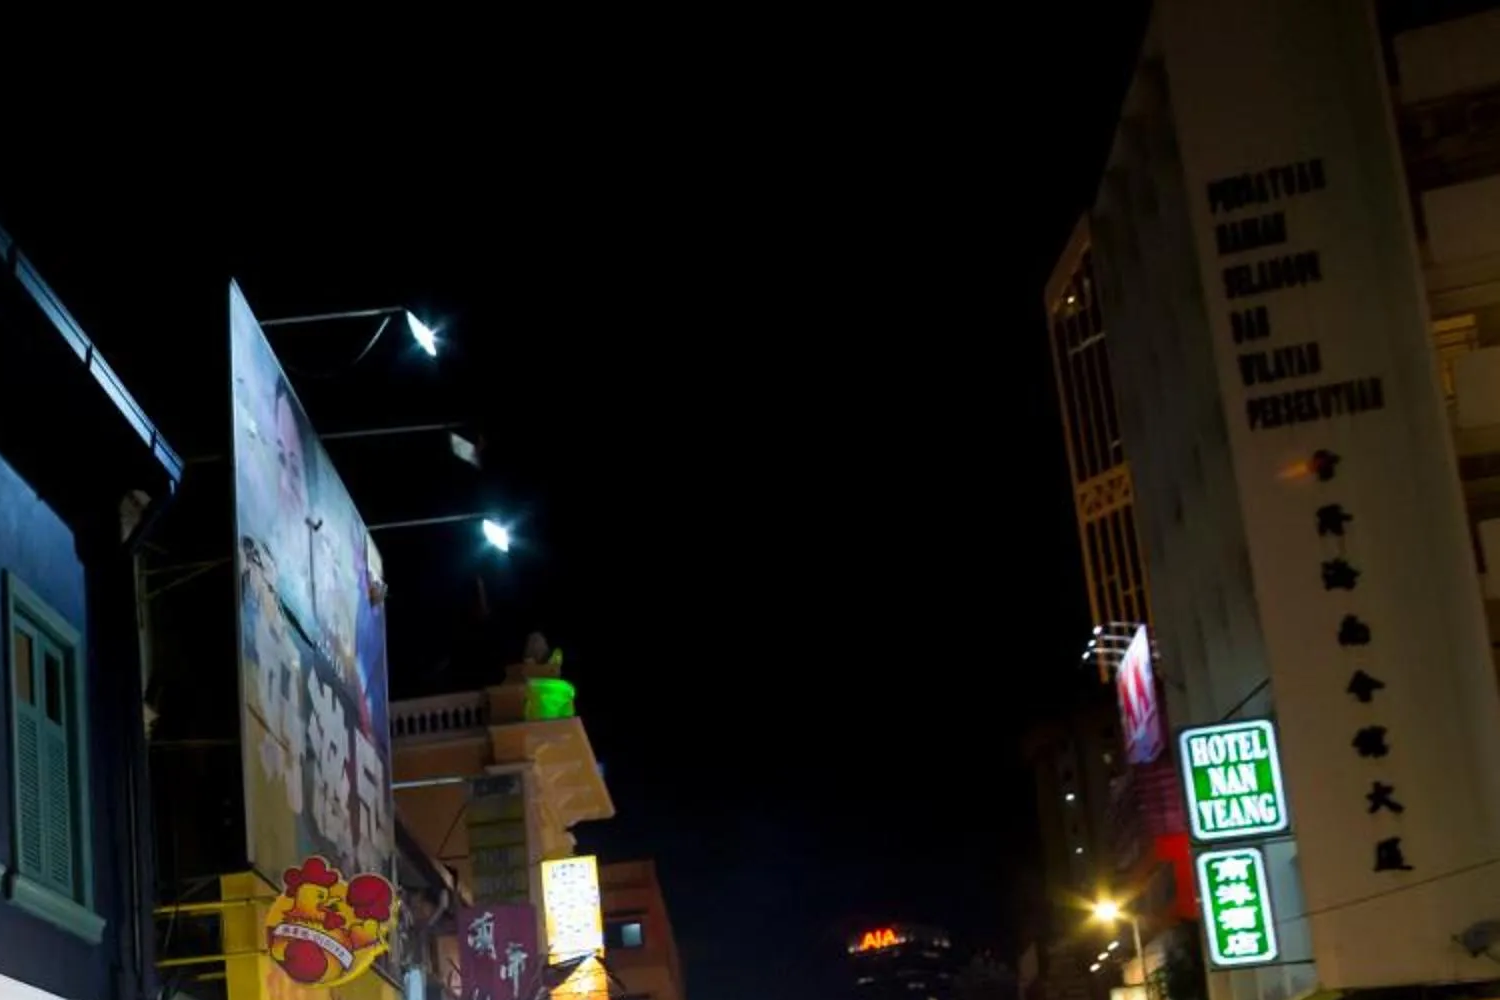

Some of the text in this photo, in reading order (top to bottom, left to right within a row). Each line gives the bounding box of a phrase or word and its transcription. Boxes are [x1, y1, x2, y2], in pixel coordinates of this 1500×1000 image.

[1222, 249, 1323, 299] SELANGOR
[1230, 305, 1270, 344] DAN
[1237, 341, 1322, 386] WILAYAH
[1246, 377, 1385, 431] PERSEKUTUAN
[1189, 729, 1268, 768] HOTEL
[1207, 762, 1257, 797] NAN
[1197, 793, 1277, 831] YEANG
[861, 928, 898, 951] AIA
